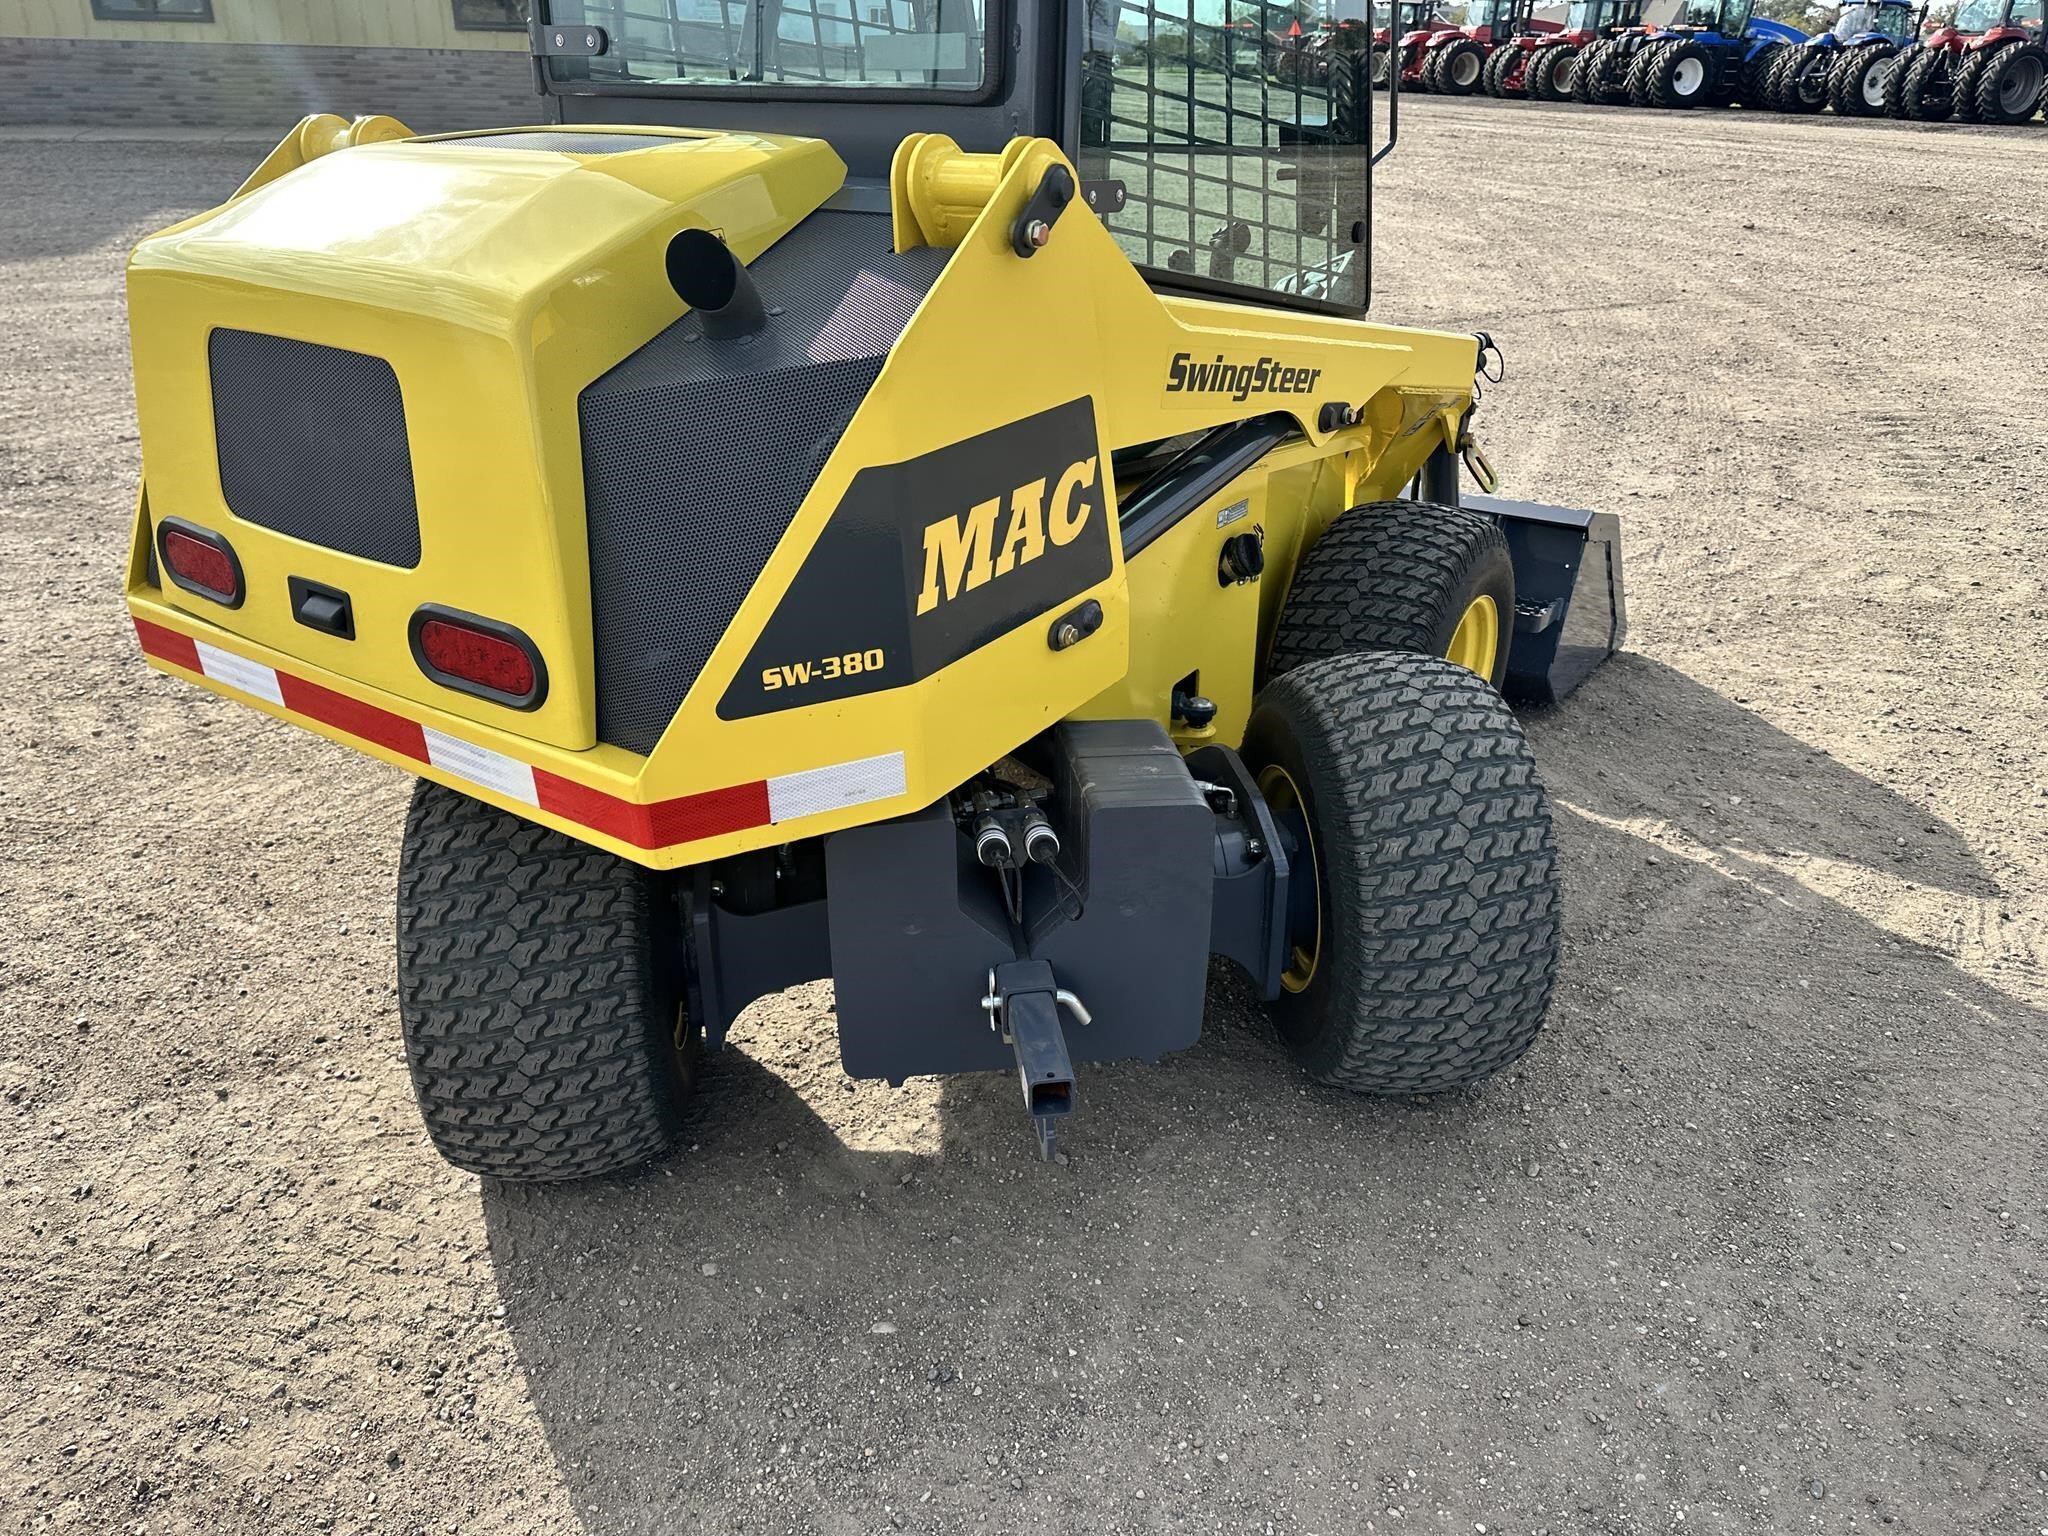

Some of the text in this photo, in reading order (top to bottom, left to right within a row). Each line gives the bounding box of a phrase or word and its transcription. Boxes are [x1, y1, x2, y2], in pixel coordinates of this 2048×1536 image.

[1166, 352, 1322, 402] SwingSteer
[916, 456, 1097, 617] MAC
[762, 648, 885, 691] SW-380
